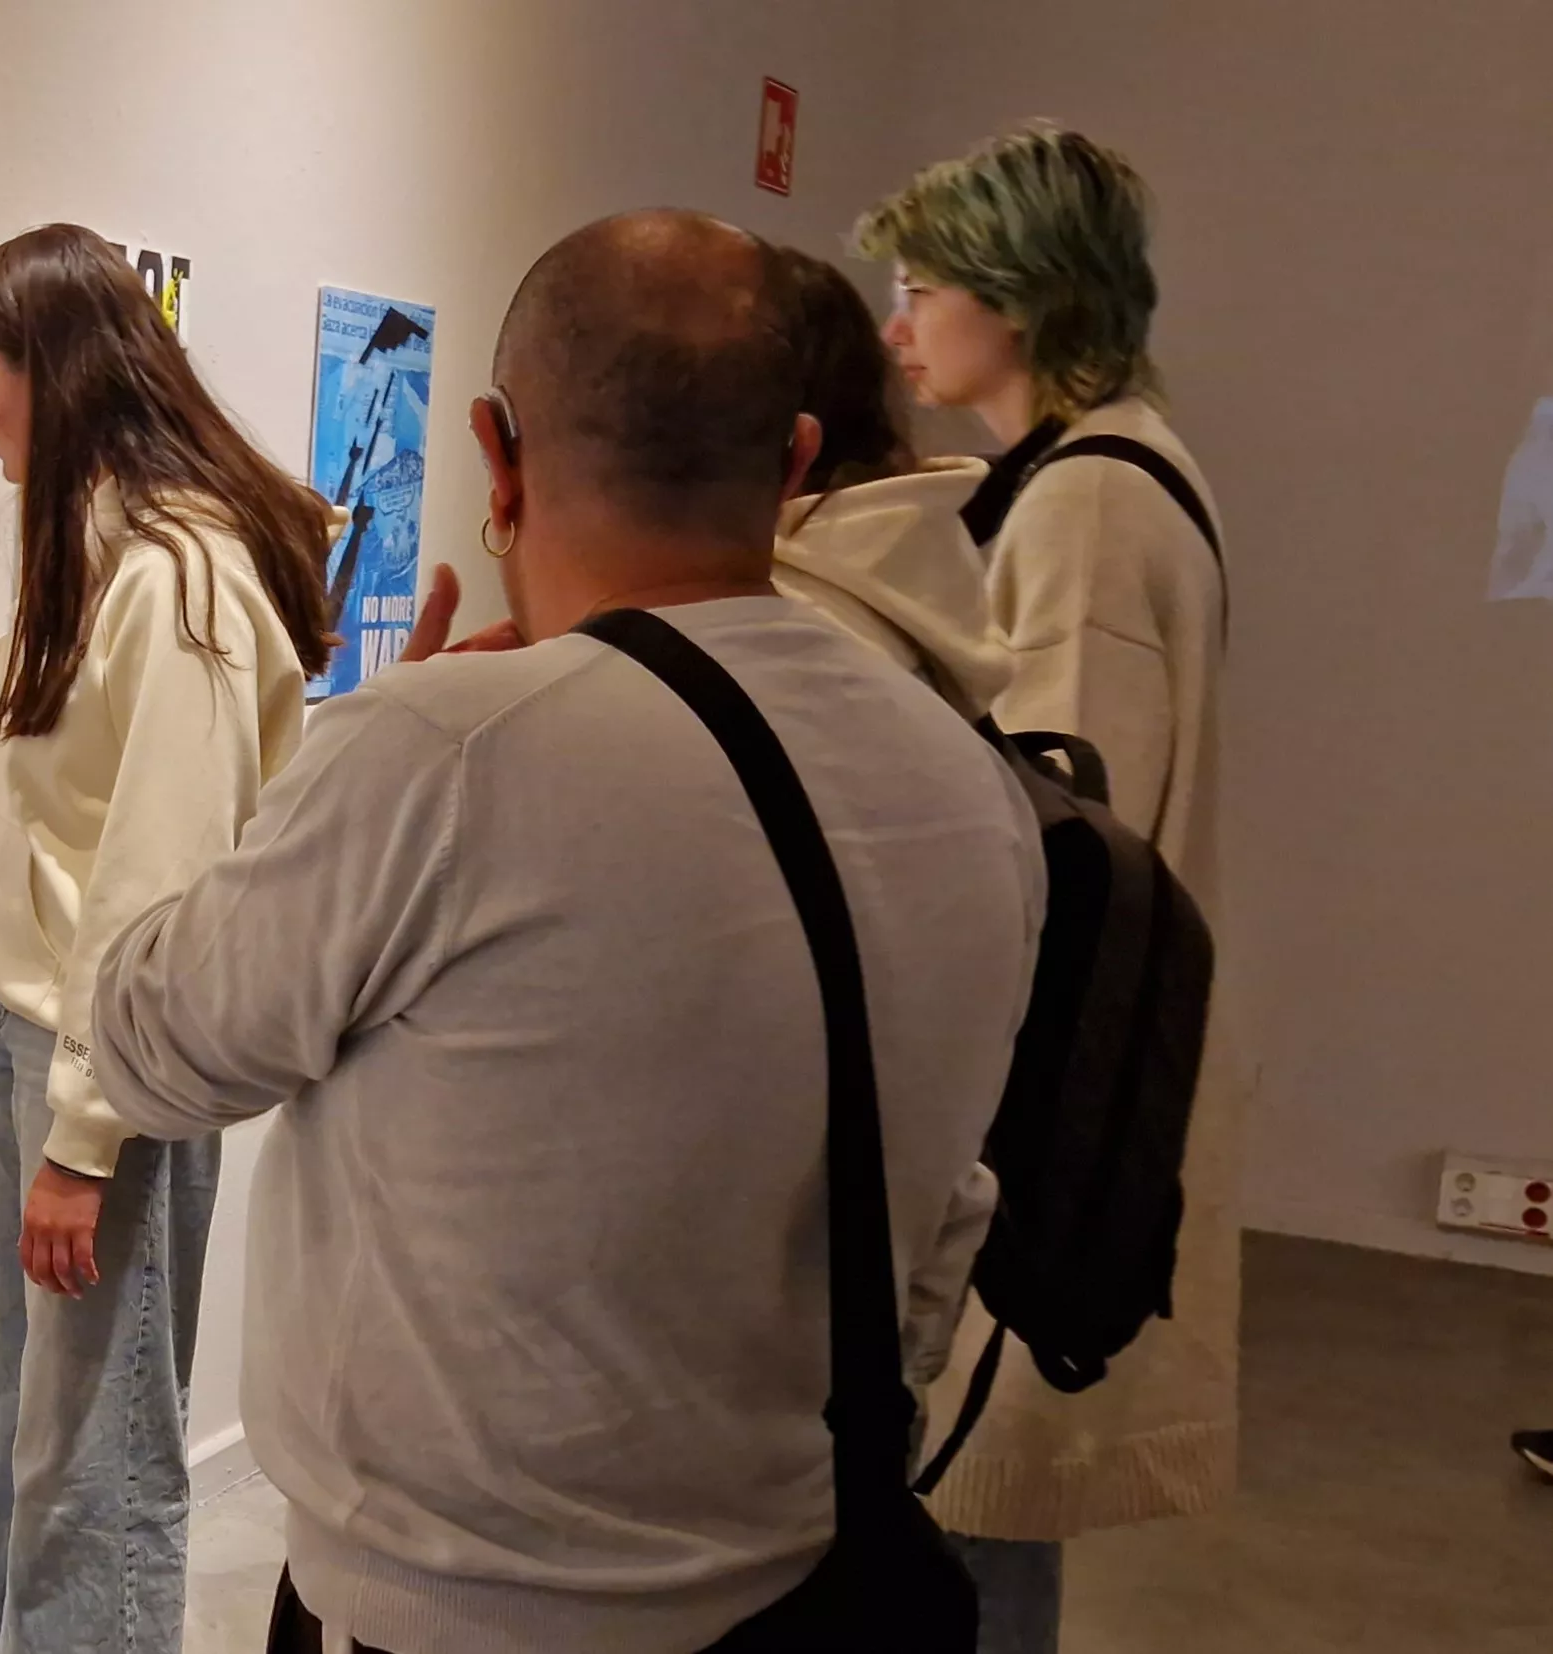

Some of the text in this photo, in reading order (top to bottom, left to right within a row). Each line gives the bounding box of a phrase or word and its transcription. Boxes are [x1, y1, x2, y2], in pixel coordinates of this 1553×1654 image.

[361, 595, 414, 624] NO MORE
[63, 1035, 92, 1065] ESSE
